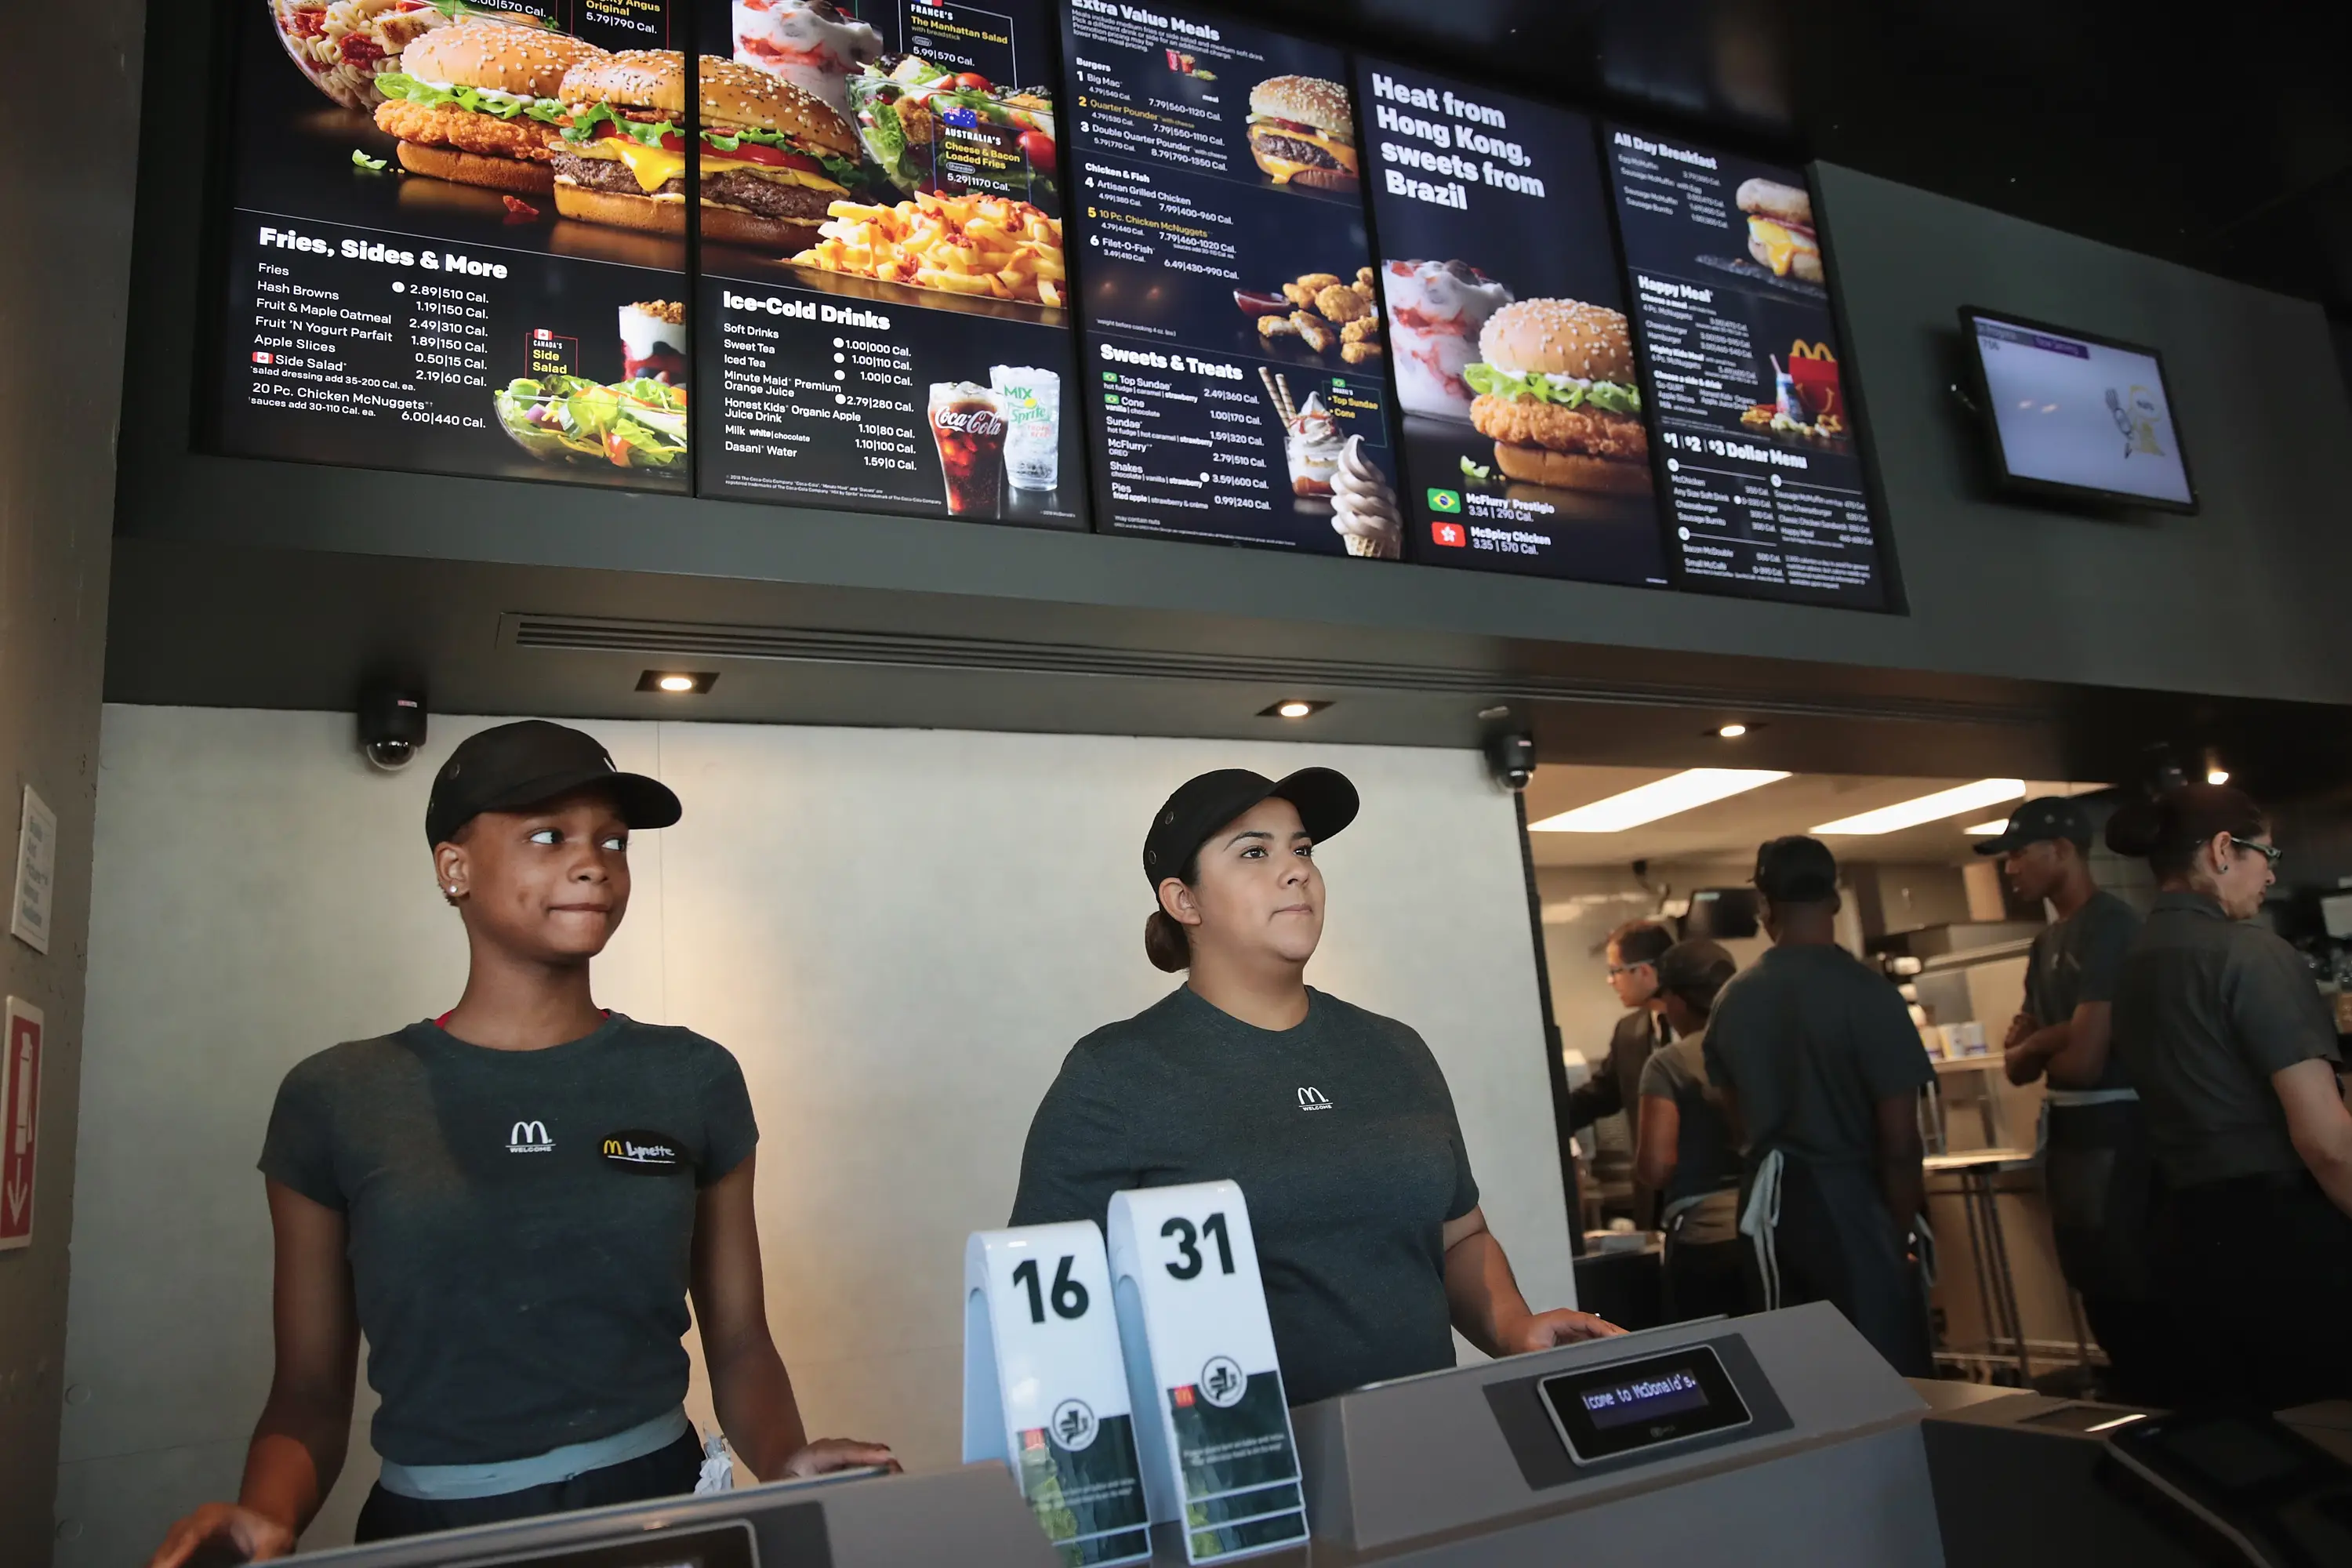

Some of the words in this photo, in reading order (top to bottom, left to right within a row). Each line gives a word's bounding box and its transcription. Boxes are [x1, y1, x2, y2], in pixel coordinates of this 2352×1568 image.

[586, 0, 630, 16] Original
[626, 0, 660, 13] Angus
[910, 4, 953, 20] FRANCE'S
[586, 12, 635, 29] 5.79|790
[637, 22, 657, 34] Cal.
[911, 16, 929, 27] The
[931, 20, 980, 38] Manhattan
[982, 31, 1008, 45] Salad
[1120, 4, 1168, 29] Value
[1171, 16, 1220, 42] Meals
[913, 46, 956, 63] 5.99|570
[957, 55, 975, 67] Cal.
[1076, 56, 1111, 72] Burgers
[1076, 71, 1083, 82] 1
[1087, 73, 1101, 87] Big
[1102, 78, 1120, 88] Mac
[1202, 94, 1219, 103] meal
[1372, 72, 1439, 111] Heat
[1443, 91, 1507, 129] from
[1078, 96, 1087, 107] 2
[1090, 100, 1122, 114] Quarter
[1123, 107, 1158, 121] Pounder
[945, 128, 1001, 146] AUSTRALIA'S
[1080, 121, 1090, 132] 3
[1092, 124, 1123, 138] Double
[1123, 131, 1155, 145] Quarter
[1156, 137, 1191, 152] Pounder
[1376, 104, 1450, 149] Hong
[1454, 124, 1531, 167] Kong,
[1614, 132, 1632, 148] All
[1632, 136, 1657, 156] Day
[945, 142, 980, 156] Cheese
[982, 148, 989, 157] &
[991, 151, 1020, 162] Bacon
[946, 152, 981, 165] Loaded
[982, 159, 1006, 170] Fries
[1084, 162, 1121, 177] Chicken
[1123, 170, 1130, 179] &
[1131, 172, 1150, 183] Fish
[1381, 142, 1479, 182] sweets
[1483, 161, 1545, 198] from
[947, 172, 991, 188] 5.29|1170
[993, 181, 1010, 192] Cal.
[1084, 176, 1094, 187] 4
[1098, 180, 1128, 193] Artisan
[1129, 185, 1156, 199] Grilled
[1158, 191, 1191, 205] Chicken
[1385, 169, 1468, 210] Brazil
[1087, 206, 1097, 218] 5
[1099, 209, 1109, 219] 10
[1110, 212, 1124, 222] Pc.
[1125, 215, 1160, 229] Chicken
[1161, 222, 1207, 238] McNuggets
[259, 227, 336, 258] Fries,
[340, 238, 415, 267] Sides
[419, 251, 440, 270] &
[445, 252, 508, 279] More
[1090, 234, 1099, 246] 6
[1102, 238, 1152, 255] Filet-O-Fish
[258, 263, 290, 277] Fries
[257, 280, 290, 294] Hash
[293, 285, 339, 300] Browns
[409, 284, 464, 301] 2.89|510
[466, 292, 489, 303] Cal.
[1638, 274, 1679, 298] Happy
[1680, 284, 1711, 303] Meal
[256, 297, 285, 312] Fruit
[289, 303, 298, 313] &
[300, 303, 338, 319] Maple
[339, 308, 392, 325] Oatmeal
[723, 290, 816, 321] Ice-Cold
[821, 304, 891, 330] Drinks
[255, 315, 286, 330] Fruit
[305, 321, 348, 339] Yogurt
[351, 328, 393, 342] Parfait
[724, 323, 746, 335] Soft
[747, 326, 779, 339] Drinks
[253, 334, 293, 349] Apple
[296, 339, 336, 353] Slices
[533, 339, 563, 350] CANADA'S
[724, 339, 756, 352] Sweet
[757, 343, 775, 354] Tea
[846, 339, 890, 354] 1.00|000
[892, 346, 912, 357] Cal.
[275, 354, 304, 368] Side
[533, 349, 560, 362] Side
[724, 354, 746, 366] Iced
[748, 357, 766, 368] Tea
[1100, 343, 1168, 369] Sweets
[1170, 355, 1185, 372] &
[1185, 357, 1243, 380] Treats
[532, 361, 568, 375] Salad
[724, 370, 760, 383] Minute
[794, 378, 841, 394] Premium
[724, 381, 763, 394] Orange
[766, 386, 794, 397] Juice
[1119, 374, 1135, 387] Top
[1137, 378, 1170, 390] Sundae
[252, 383, 270, 394] 20
[273, 384, 294, 397] Pc.
[297, 387, 350, 403] Chicken
[1004, 385, 1033, 399] MIX
[724, 397, 762, 411] Honest
[791, 405, 830, 419] Organic
[833, 409, 862, 423] Apple
[1121, 397, 1145, 408] Cone
[1333, 395, 1348, 405] Top
[1349, 398, 1378, 410] Sundae
[401, 410, 460, 426] 6.00|440
[462, 416, 486, 429] Cal.
[724, 408, 753, 420] Juice
[756, 412, 782, 423] Drink
[1011, 406, 1047, 424] Sprite
[1106, 416, 1141, 429] Sundae
[1334, 408, 1356, 419] Cone
[725, 425, 746, 436] Milk
[767, 445, 797, 457] Water
[1108, 438, 1146, 452] McFlurry
[1109, 448, 1128, 457] OREO
[1110, 461, 1143, 474] Shakes
[1112, 482, 1131, 493] Pies
[1465, 492, 1508, 509] McFlurry
[1512, 497, 1555, 514] Prestigio
[1471, 526, 1511, 543] McSpicy
[1512, 531, 1552, 546] Chicken
[626, 1141, 675, 1161] Lynette
[1160, 1212, 1236, 1280] 31
[1012, 1254, 1091, 1324] 16
[1618, 1388, 1632, 1403] to
